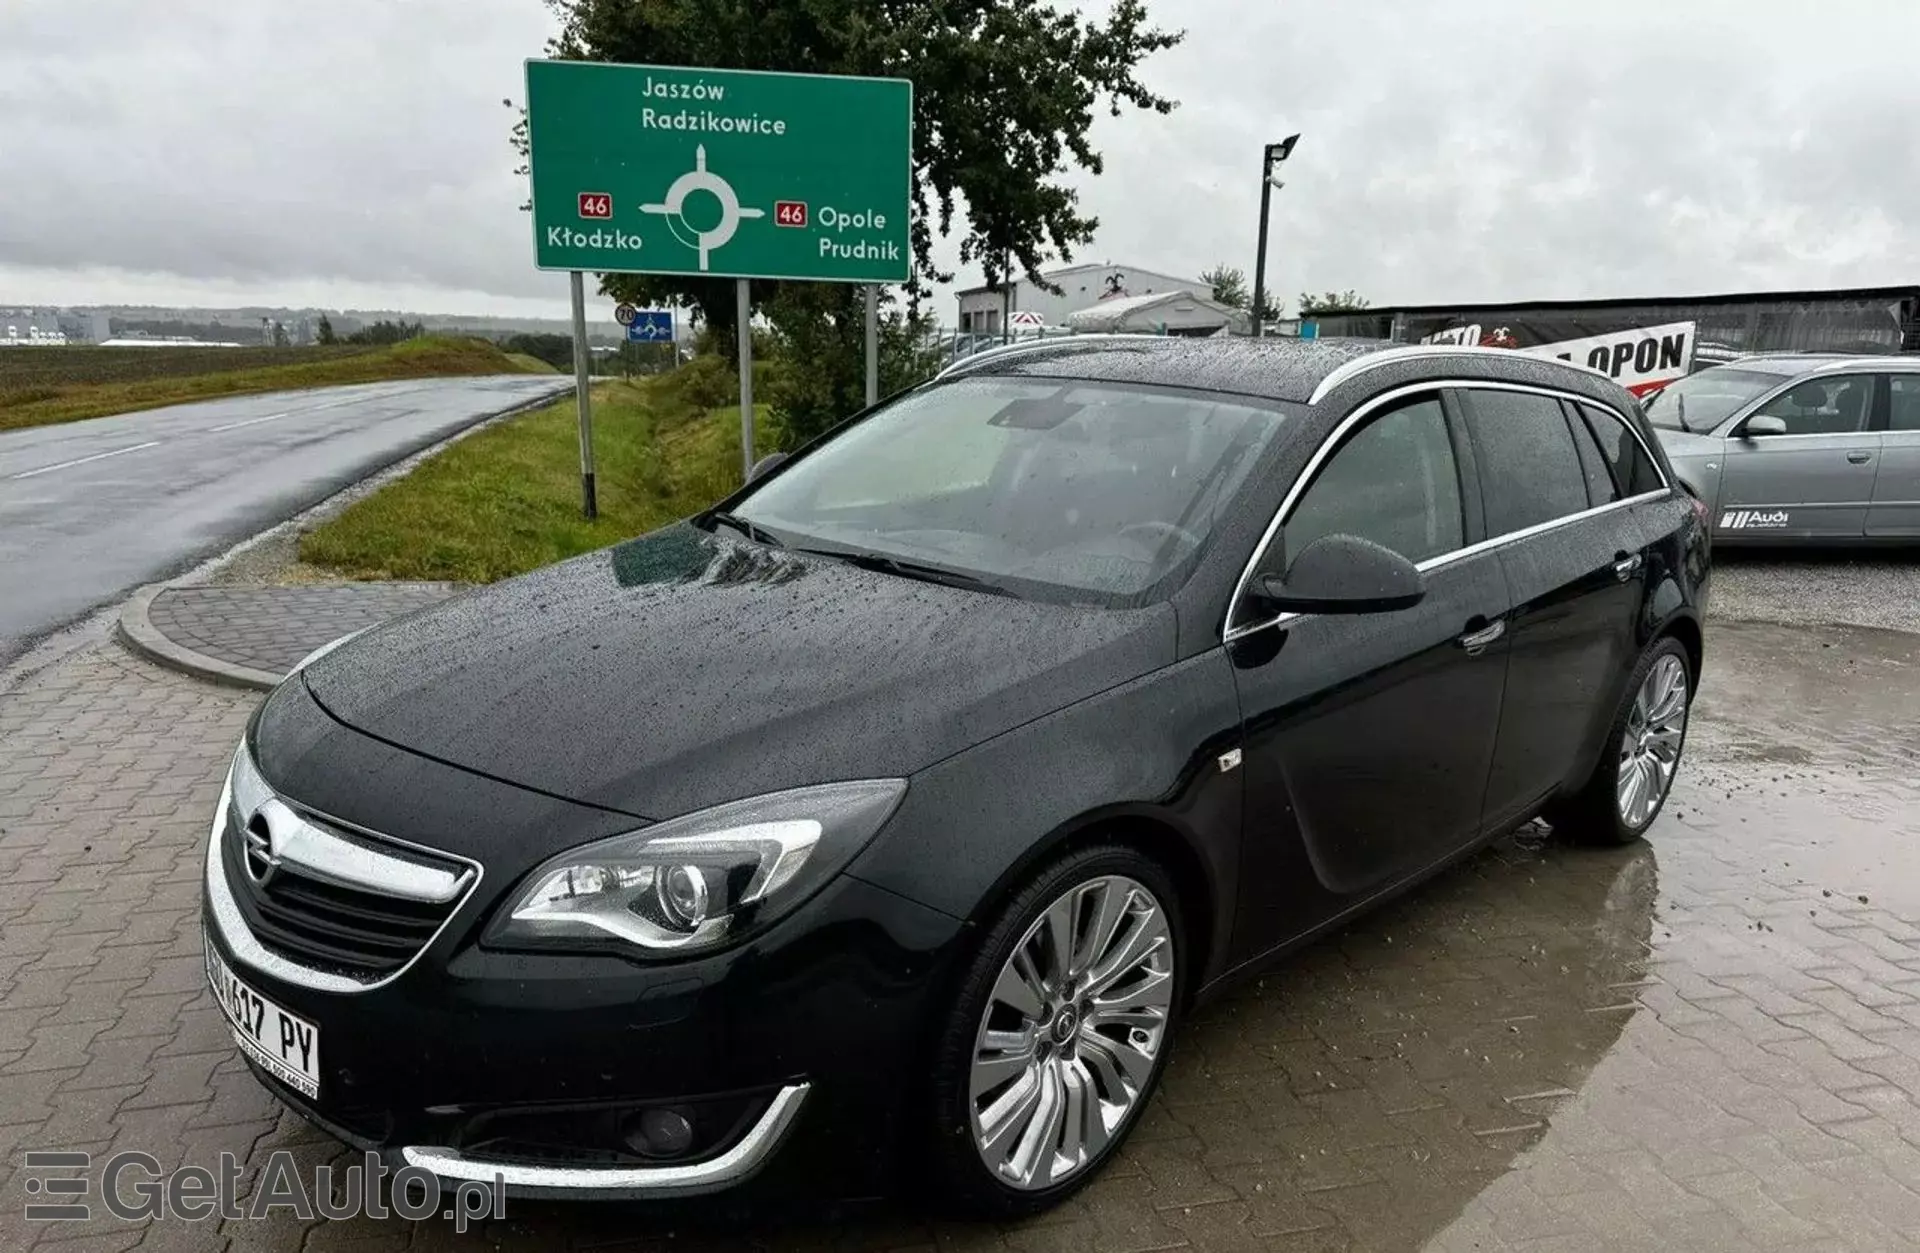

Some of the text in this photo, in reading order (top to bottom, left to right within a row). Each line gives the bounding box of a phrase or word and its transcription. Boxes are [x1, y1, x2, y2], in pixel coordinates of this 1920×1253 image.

[642, 77, 725, 100] Jaszów
[642, 108, 786, 135] Radzikowice
[584, 198, 607, 214] 46
[779, 206, 803, 223] 46
[818, 206, 886, 232] Opole
[547, 226, 643, 250] Kłodzko
[819, 239, 899, 261] Prudnik
[620, 309, 633, 317] 70
[1588, 333, 1685, 378] OPON
[1748, 511, 1789, 523] Audi
[278, 1011, 312, 1073] PY
